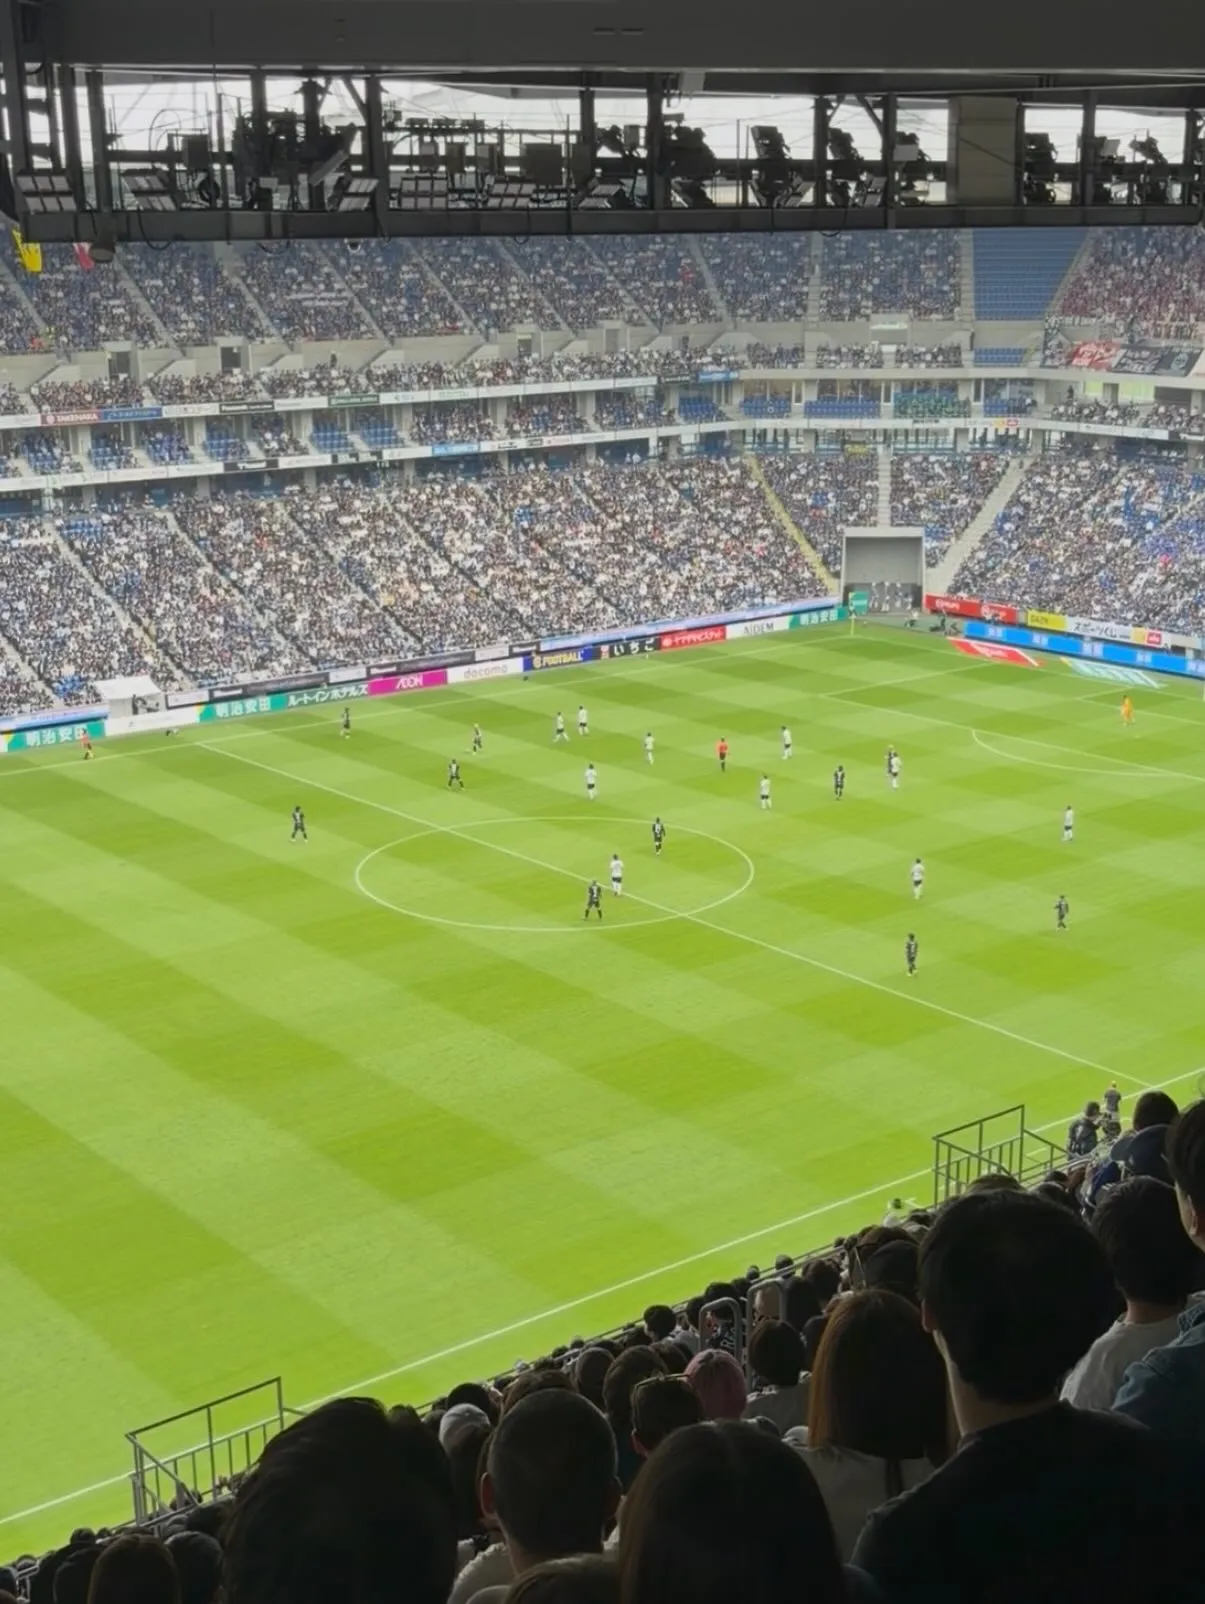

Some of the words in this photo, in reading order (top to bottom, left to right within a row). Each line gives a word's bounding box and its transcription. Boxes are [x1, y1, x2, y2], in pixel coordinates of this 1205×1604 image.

[614, 637, 655, 656] いちご
[464, 663, 508, 679] docomo
[216, 697, 270, 717] 明治安田
